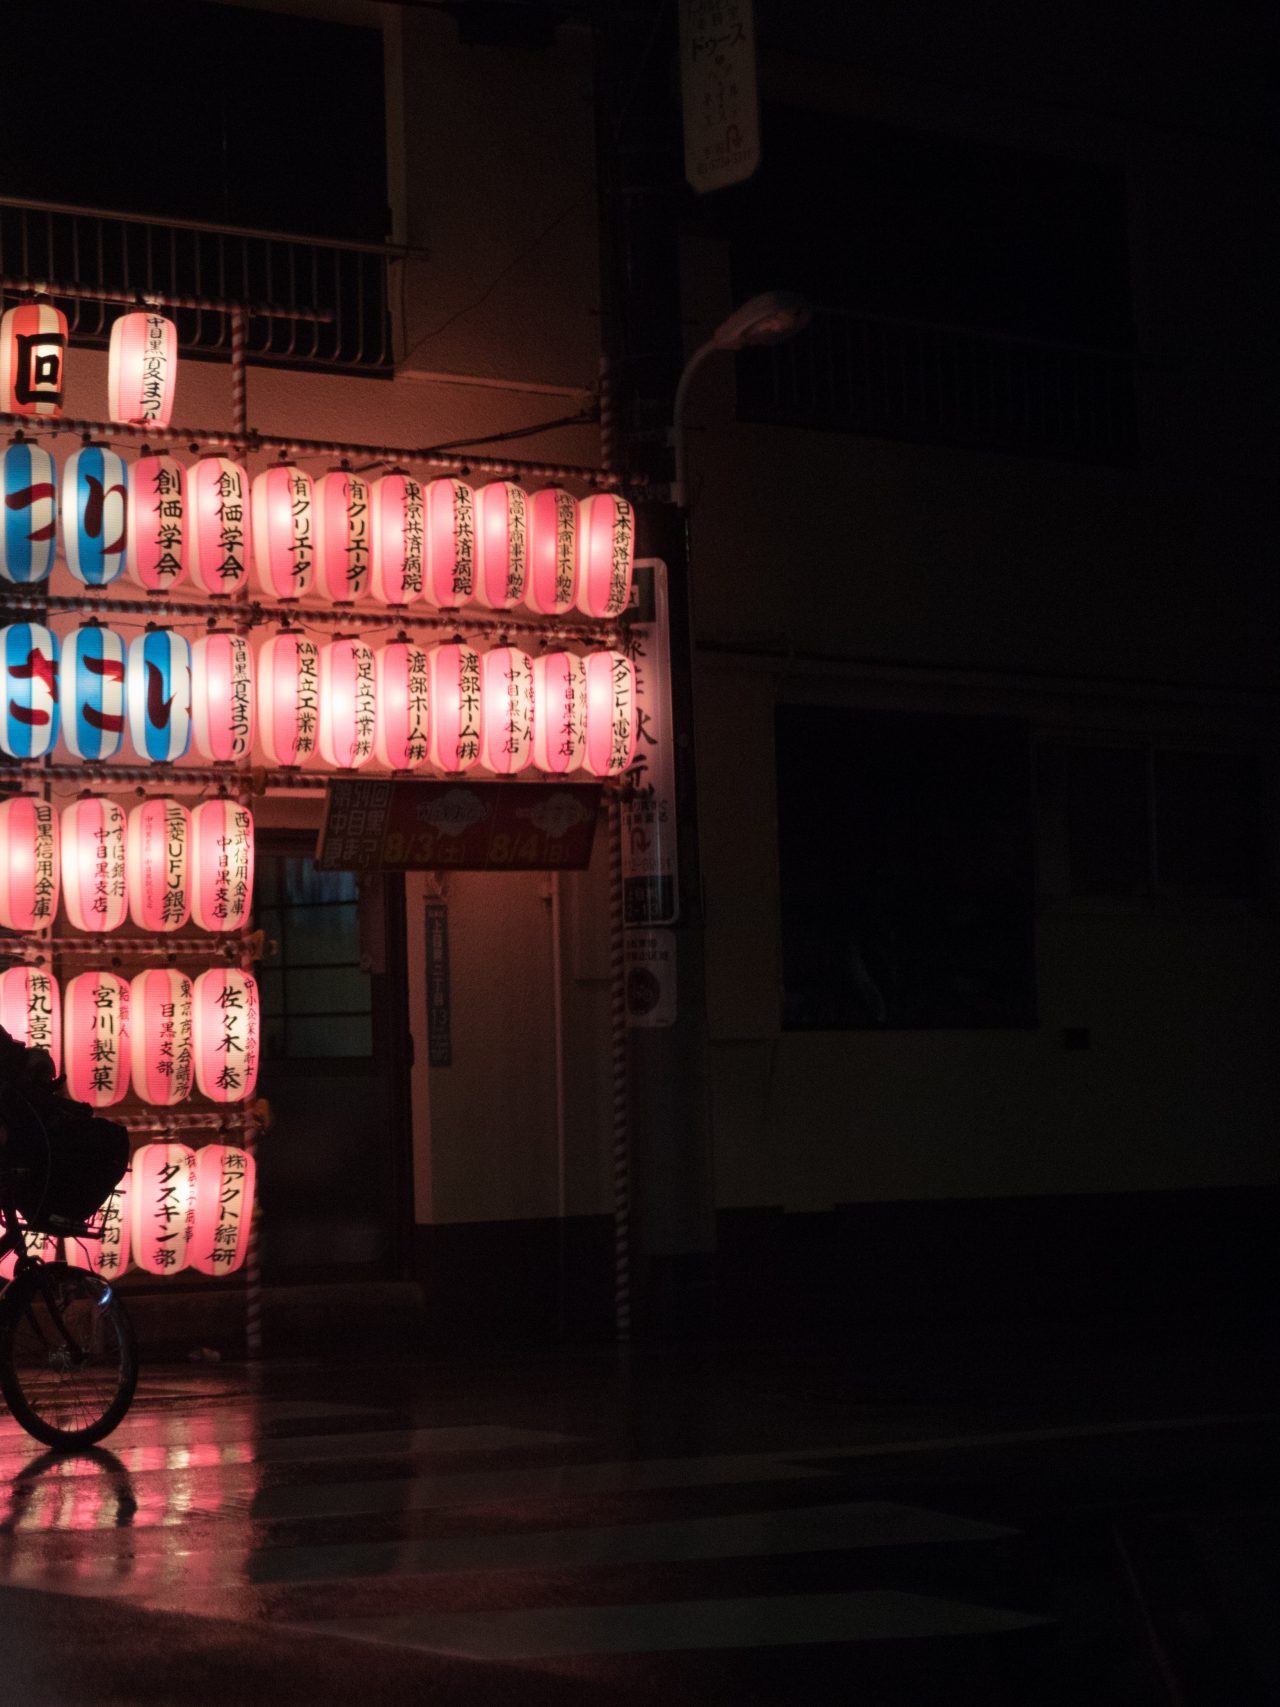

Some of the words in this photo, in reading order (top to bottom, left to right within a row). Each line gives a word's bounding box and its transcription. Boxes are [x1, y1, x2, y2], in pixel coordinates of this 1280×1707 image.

[140, 317, 167, 420] 中目黒夏まつり
[153, 469, 183, 576] 創価学会
[215, 472, 244, 580] 創価学会
[401, 482, 423, 593] 東京共済病院
[451, 486, 472, 596] 東京共済病院
[229, 639, 250, 754] 中目黒夏まつり
[502, 668, 521, 754] 中目黒本店
[559, 672, 576, 756] 中目黒本店
[30, 806, 54, 919] 目黒信用金庫
[91, 828, 110, 913] 中目黒支店
[109, 807, 126, 897] みずほ銀行
[161, 807, 185, 924] 三菱UFJ銀行
[230, 812, 250, 915] 西武信用金庫
[330, 809, 385, 836] 中目黒
[212, 836, 231, 918] 中目黒支店
[89, 985, 116, 1092] 宮川製菓
[156, 1003, 176, 1077] 目黒支部
[172, 980, 192, 1097] 東京商工会議所
[215, 986, 244, 1090] 佐々木泰
